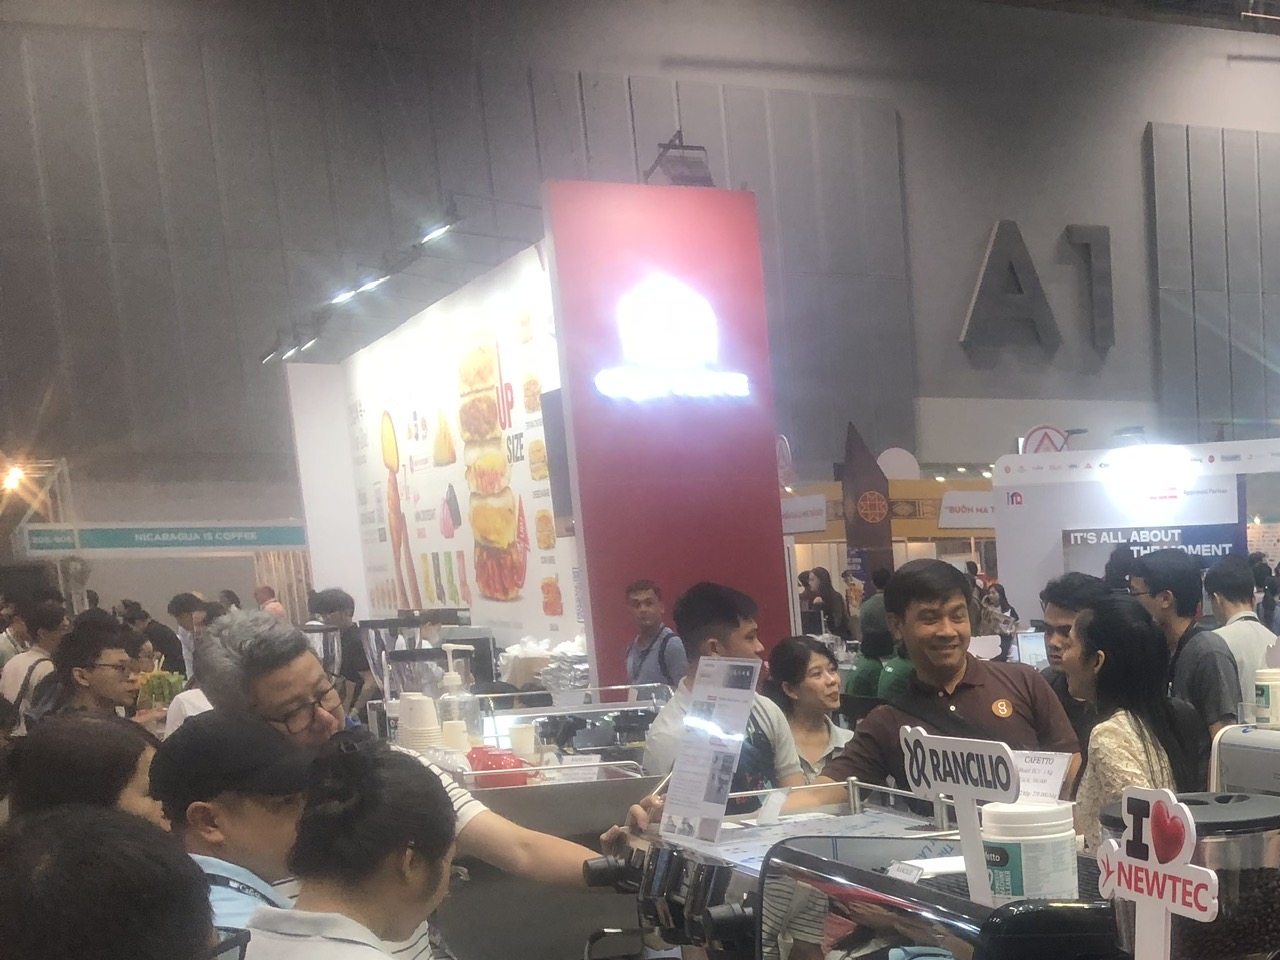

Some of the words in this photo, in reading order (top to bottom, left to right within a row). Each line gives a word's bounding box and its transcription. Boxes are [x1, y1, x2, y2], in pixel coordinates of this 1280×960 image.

[959, 219, 1115, 351] A1
[507, 433, 525, 464] SIZE
[135, 532, 201, 542] NICARAGUA
[1070, 532, 1097, 545] IT'S
[1100, 531, 1127, 544] ALL
[1130, 529, 1182, 543] ABOUT
[1163, 543, 1233, 557] OMENT
[928, 748, 1011, 792] RANCILIO
[1024, 756, 1055, 766] CAFETTO
[1126, 796, 1150, 861] I
[1117, 861, 1209, 912] NEWTEC
